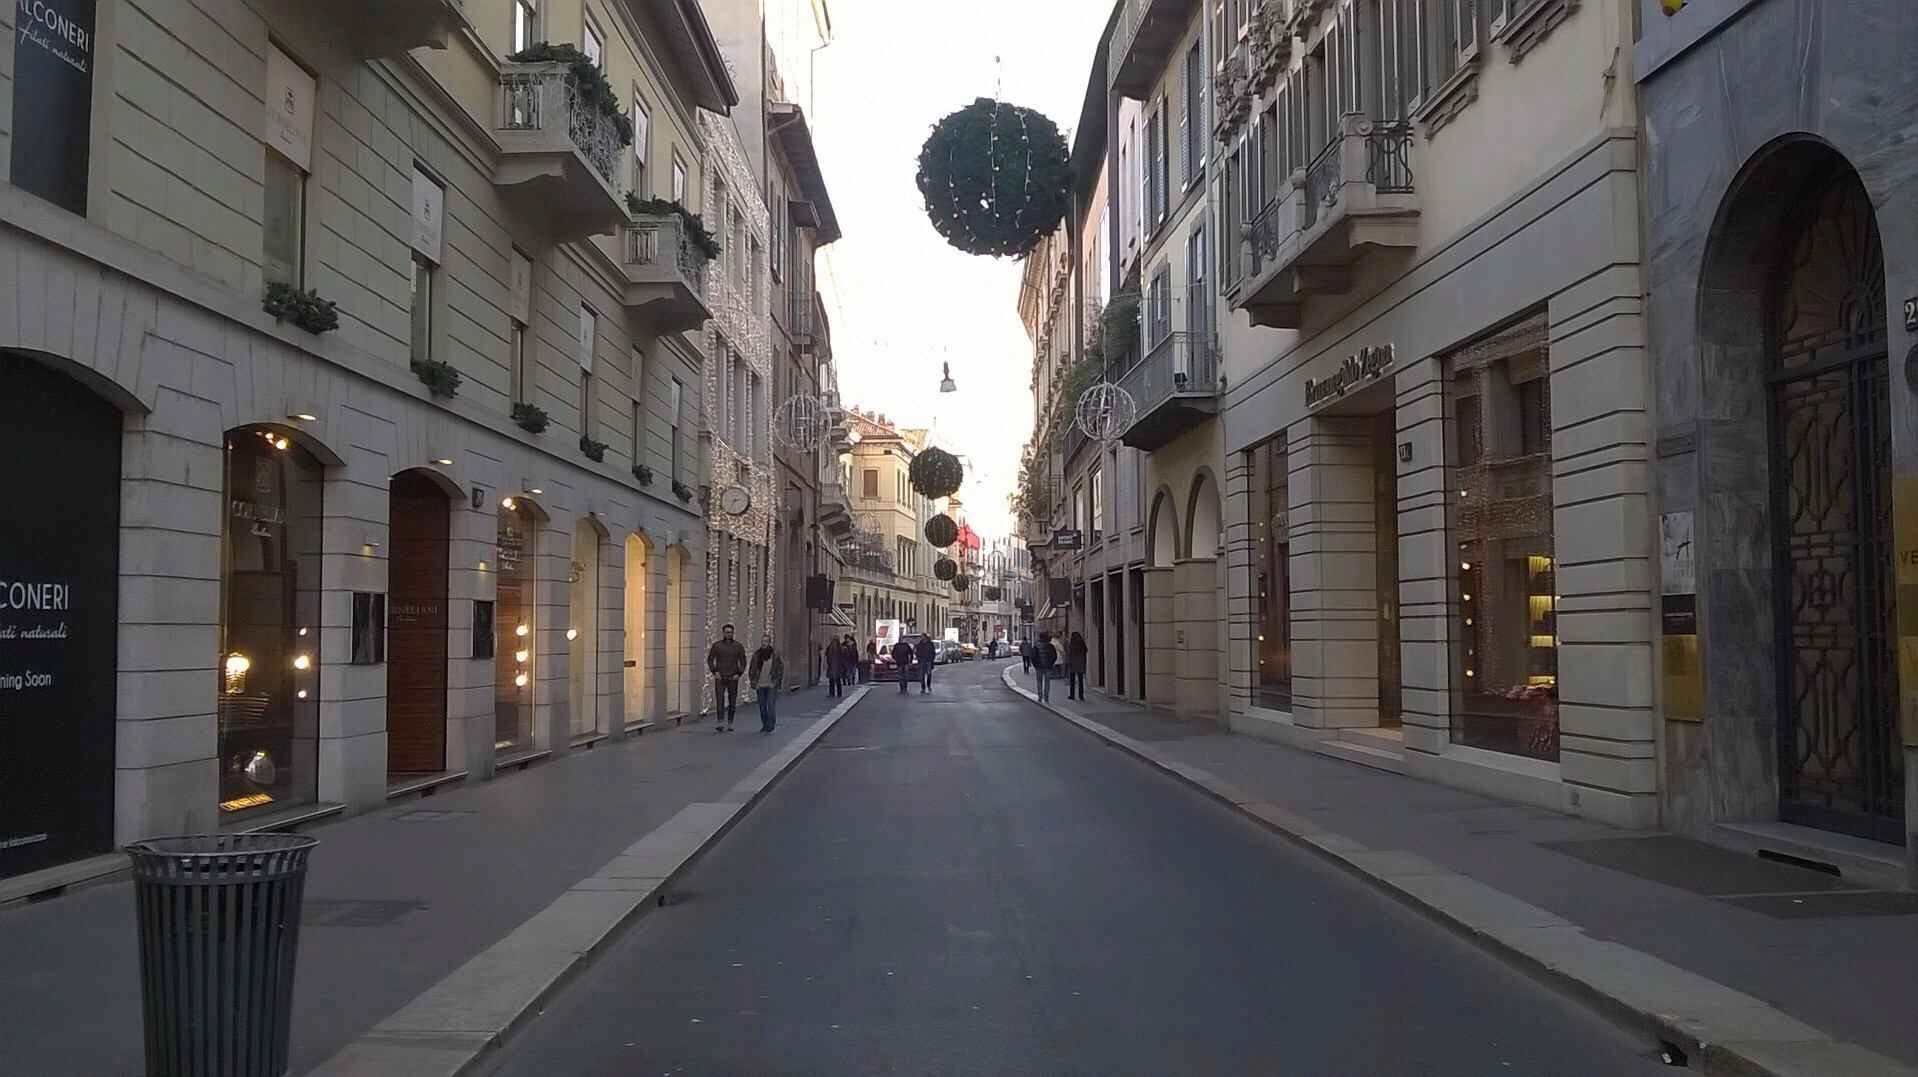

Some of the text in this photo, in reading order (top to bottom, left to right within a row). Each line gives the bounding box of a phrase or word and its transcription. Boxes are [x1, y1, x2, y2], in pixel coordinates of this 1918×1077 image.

[20, 0, 89, 53] LCONERI
[1360, 343, 1394, 379] Zegna
[21, 621, 68, 640] naturali
[25, 669, 52, 687] Soon
